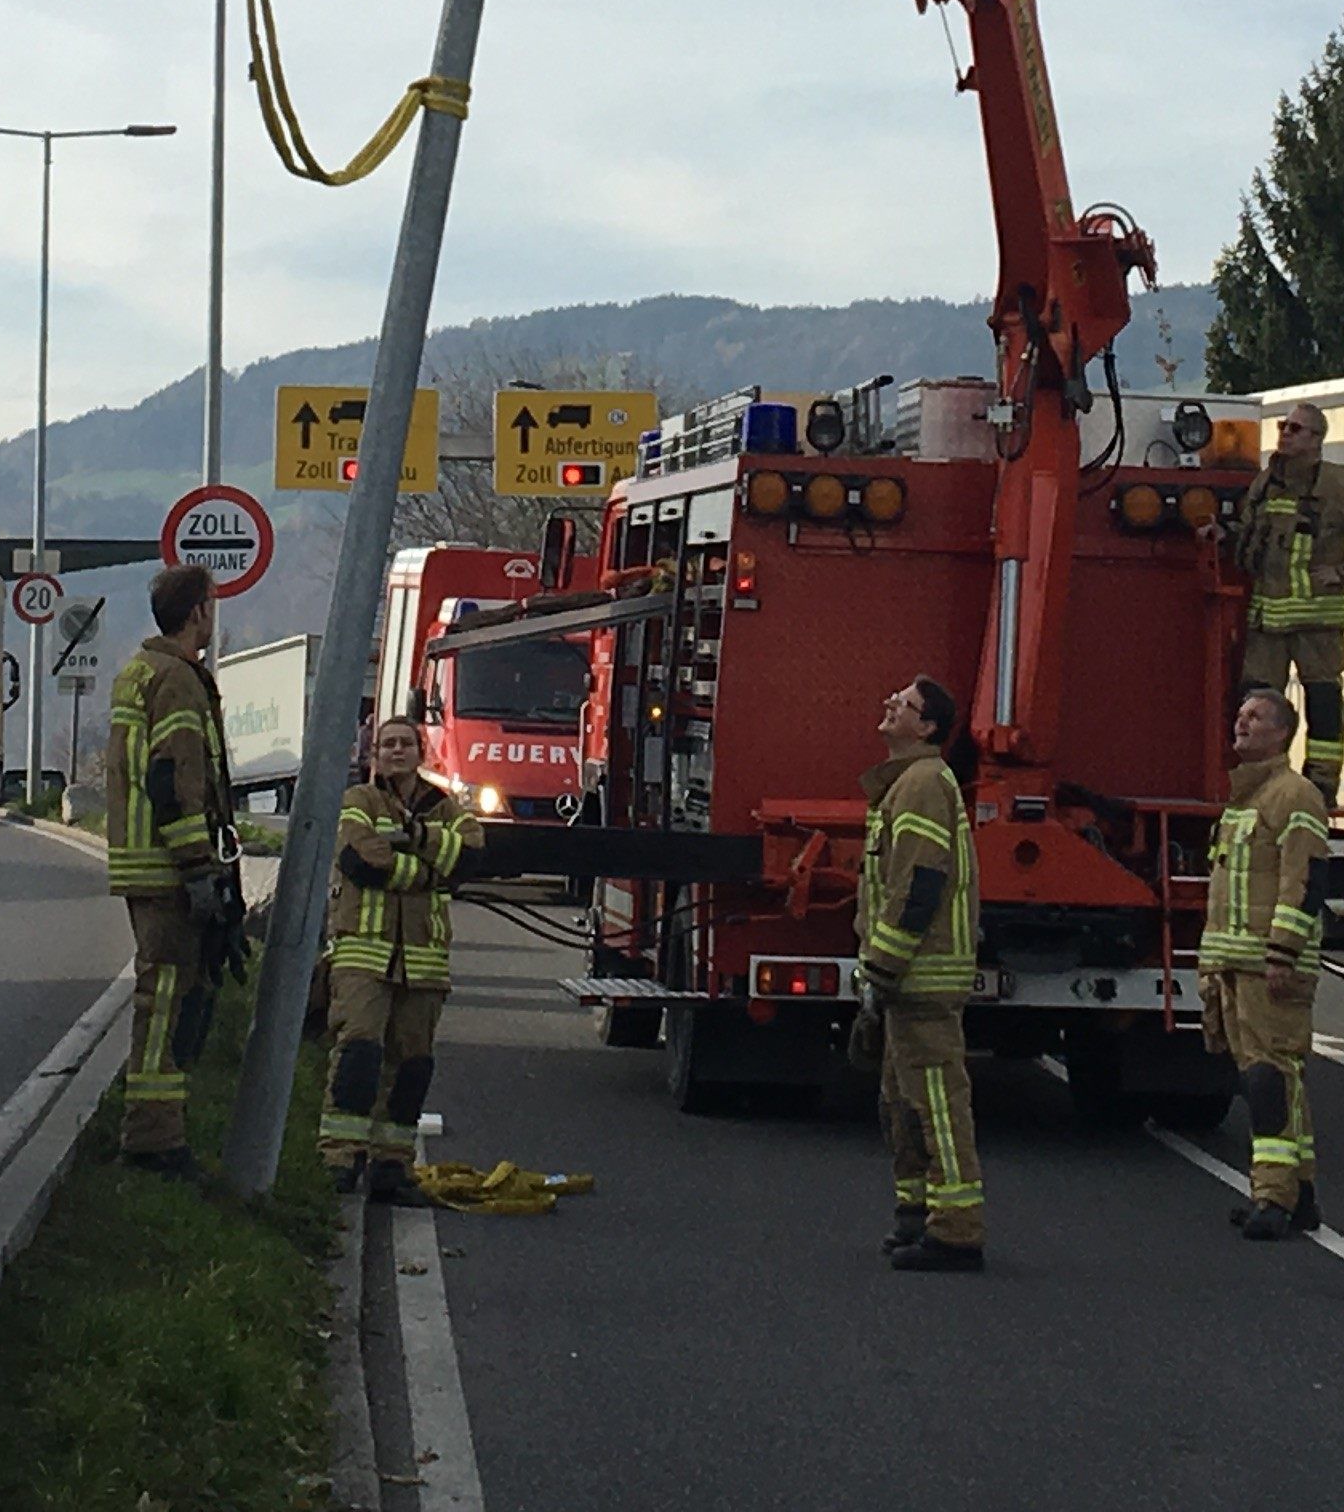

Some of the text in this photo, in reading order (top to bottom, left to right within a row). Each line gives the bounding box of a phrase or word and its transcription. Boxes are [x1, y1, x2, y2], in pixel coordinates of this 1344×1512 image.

[295, 460, 332, 480] Zoll
[515, 464, 551, 484] Zoll
[188, 514, 247, 535] ZOLL
[26, 586, 52, 610] 20
